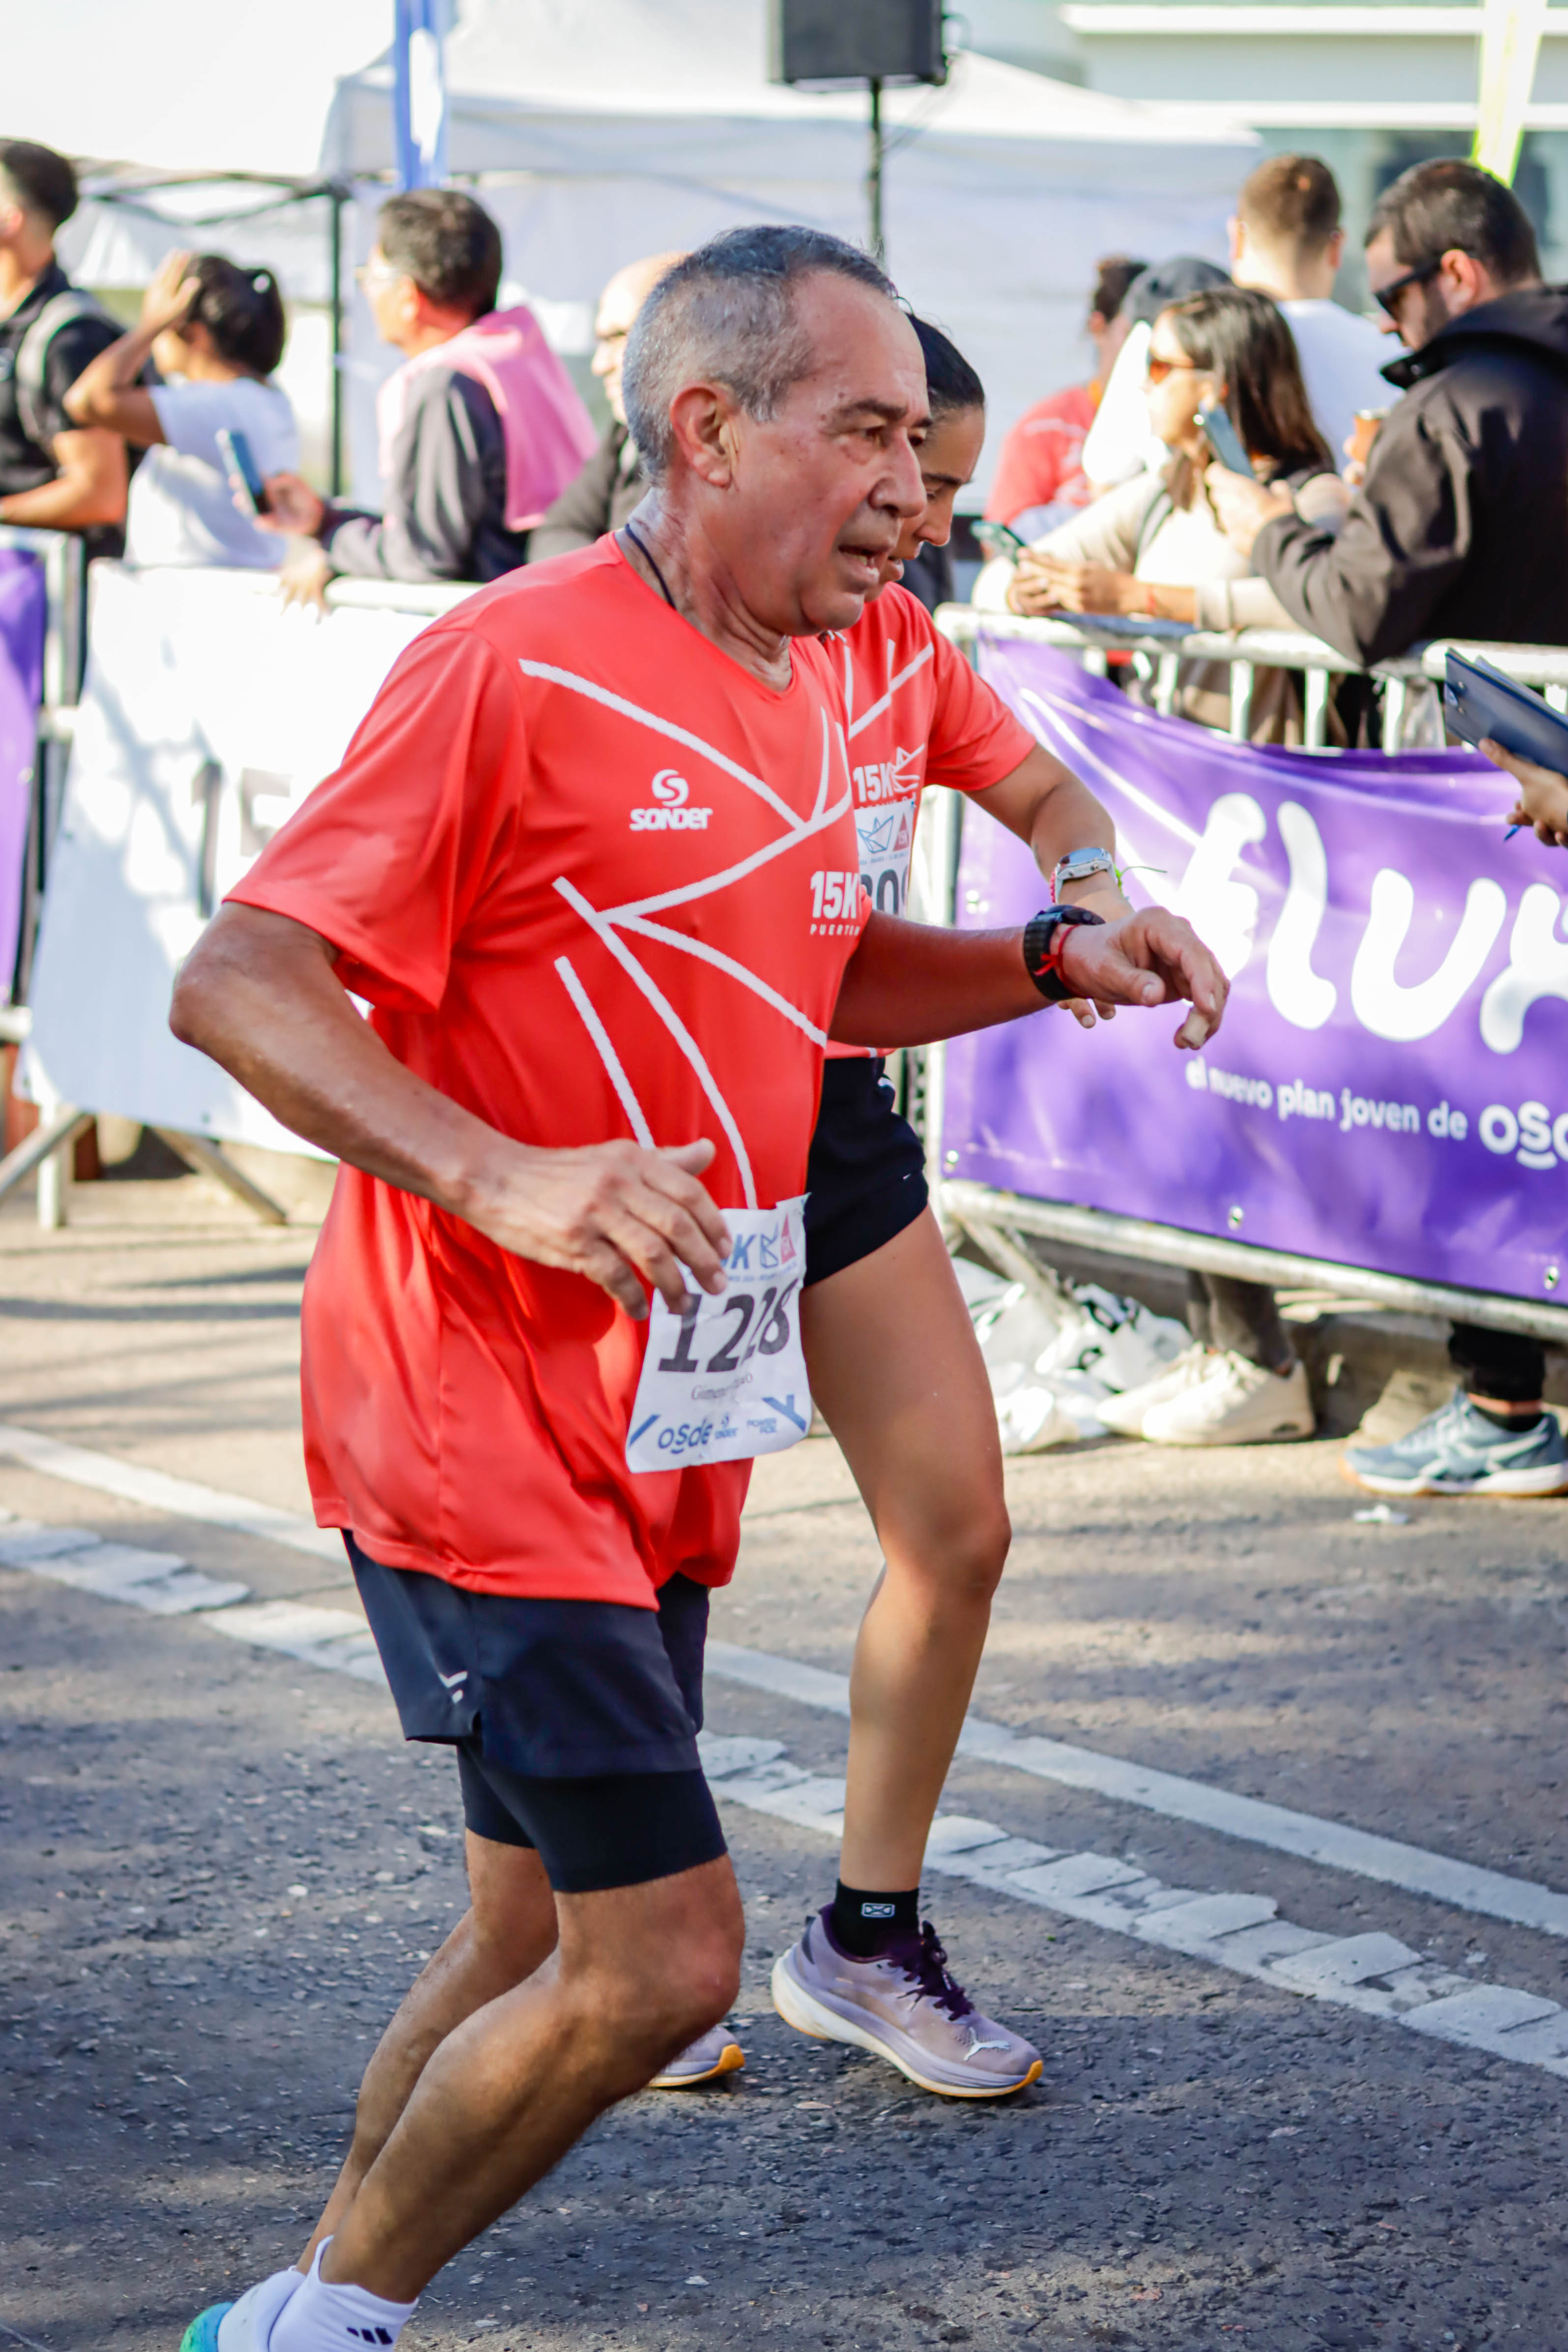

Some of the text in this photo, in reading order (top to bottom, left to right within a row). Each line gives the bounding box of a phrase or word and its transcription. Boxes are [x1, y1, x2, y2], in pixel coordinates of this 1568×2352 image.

[853, 763, 894, 803] 15K
[810, 871, 859, 919] 15K
[1185, 1056, 1207, 1090] el
[1209, 1067, 1273, 1110] nuevo
[1278, 1079, 1335, 1120] plan
[1339, 1088, 1420, 1132] joven
[1427, 1100, 1468, 1140] de
